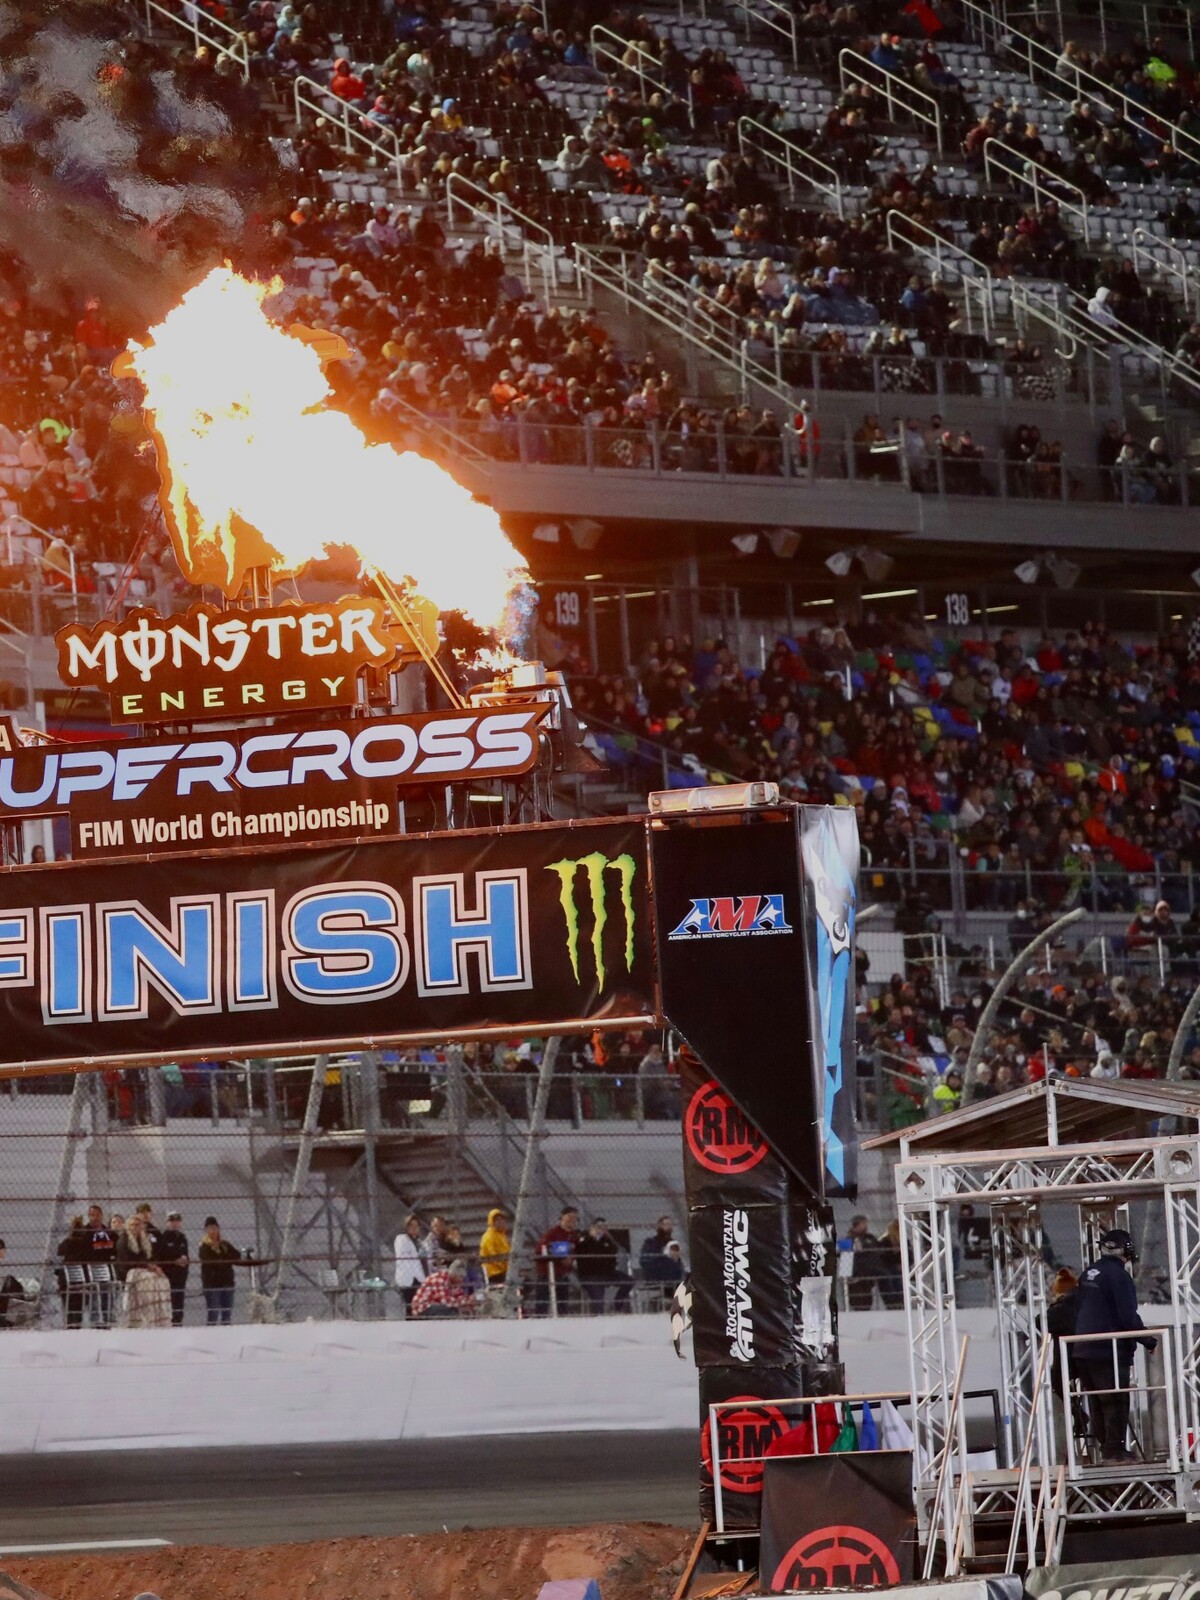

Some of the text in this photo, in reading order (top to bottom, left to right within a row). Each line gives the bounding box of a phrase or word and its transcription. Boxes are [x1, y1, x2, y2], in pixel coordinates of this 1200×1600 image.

[555, 592, 579, 625] 139
[945, 593, 969, 625] 138
[66, 608, 388, 682] MONSTER
[121, 676, 348, 715] ENERGY
[79, 798, 390, 848] FIM World Championship
[668, 894, 793, 935] AMA
[751, 928, 794, 936] ASSOCIATION
[723, 1209, 737, 1339] ROCKY MOUNTAIN
